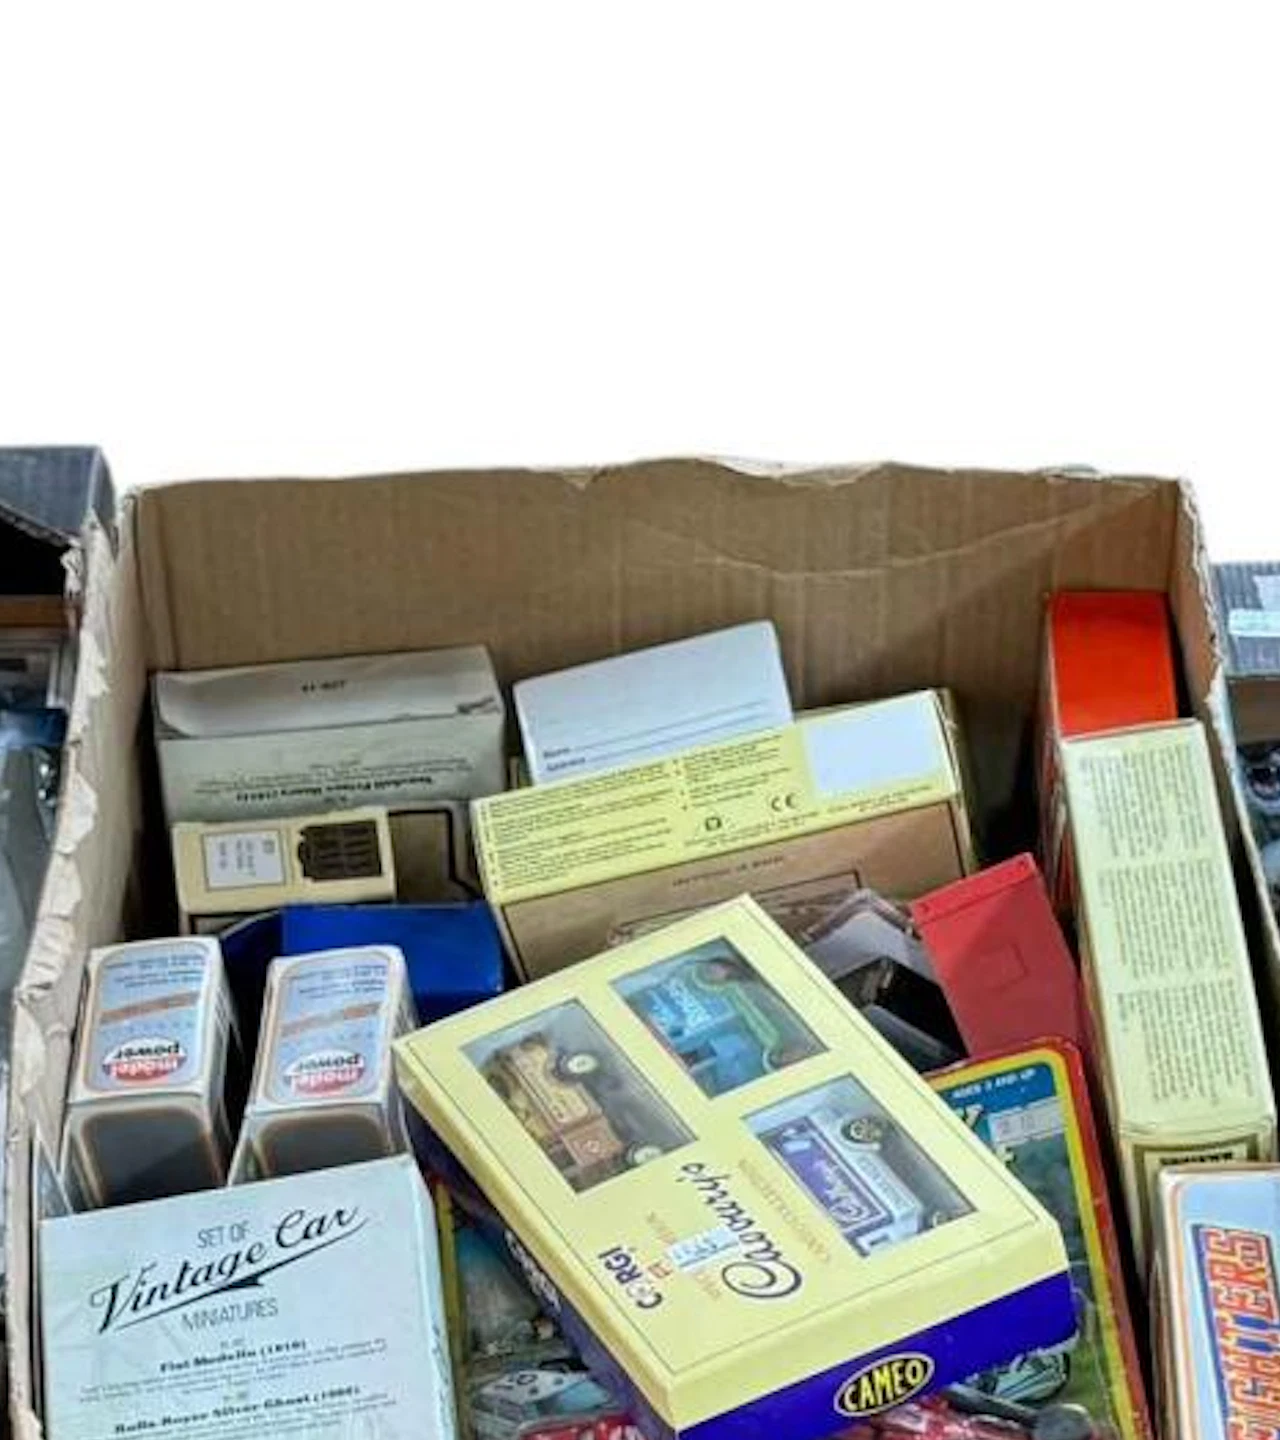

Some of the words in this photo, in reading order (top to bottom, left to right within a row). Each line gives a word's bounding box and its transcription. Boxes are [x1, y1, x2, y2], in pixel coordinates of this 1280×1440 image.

[197, 1229, 224, 1249] SET
[227, 1220, 250, 1241] OF
[90, 1241, 267, 1333] Vintage
[275, 1207, 359, 1249] Car
[181, 1297, 279, 1332] MINIATURES
[841, 1357, 926, 1412] CAMEO
